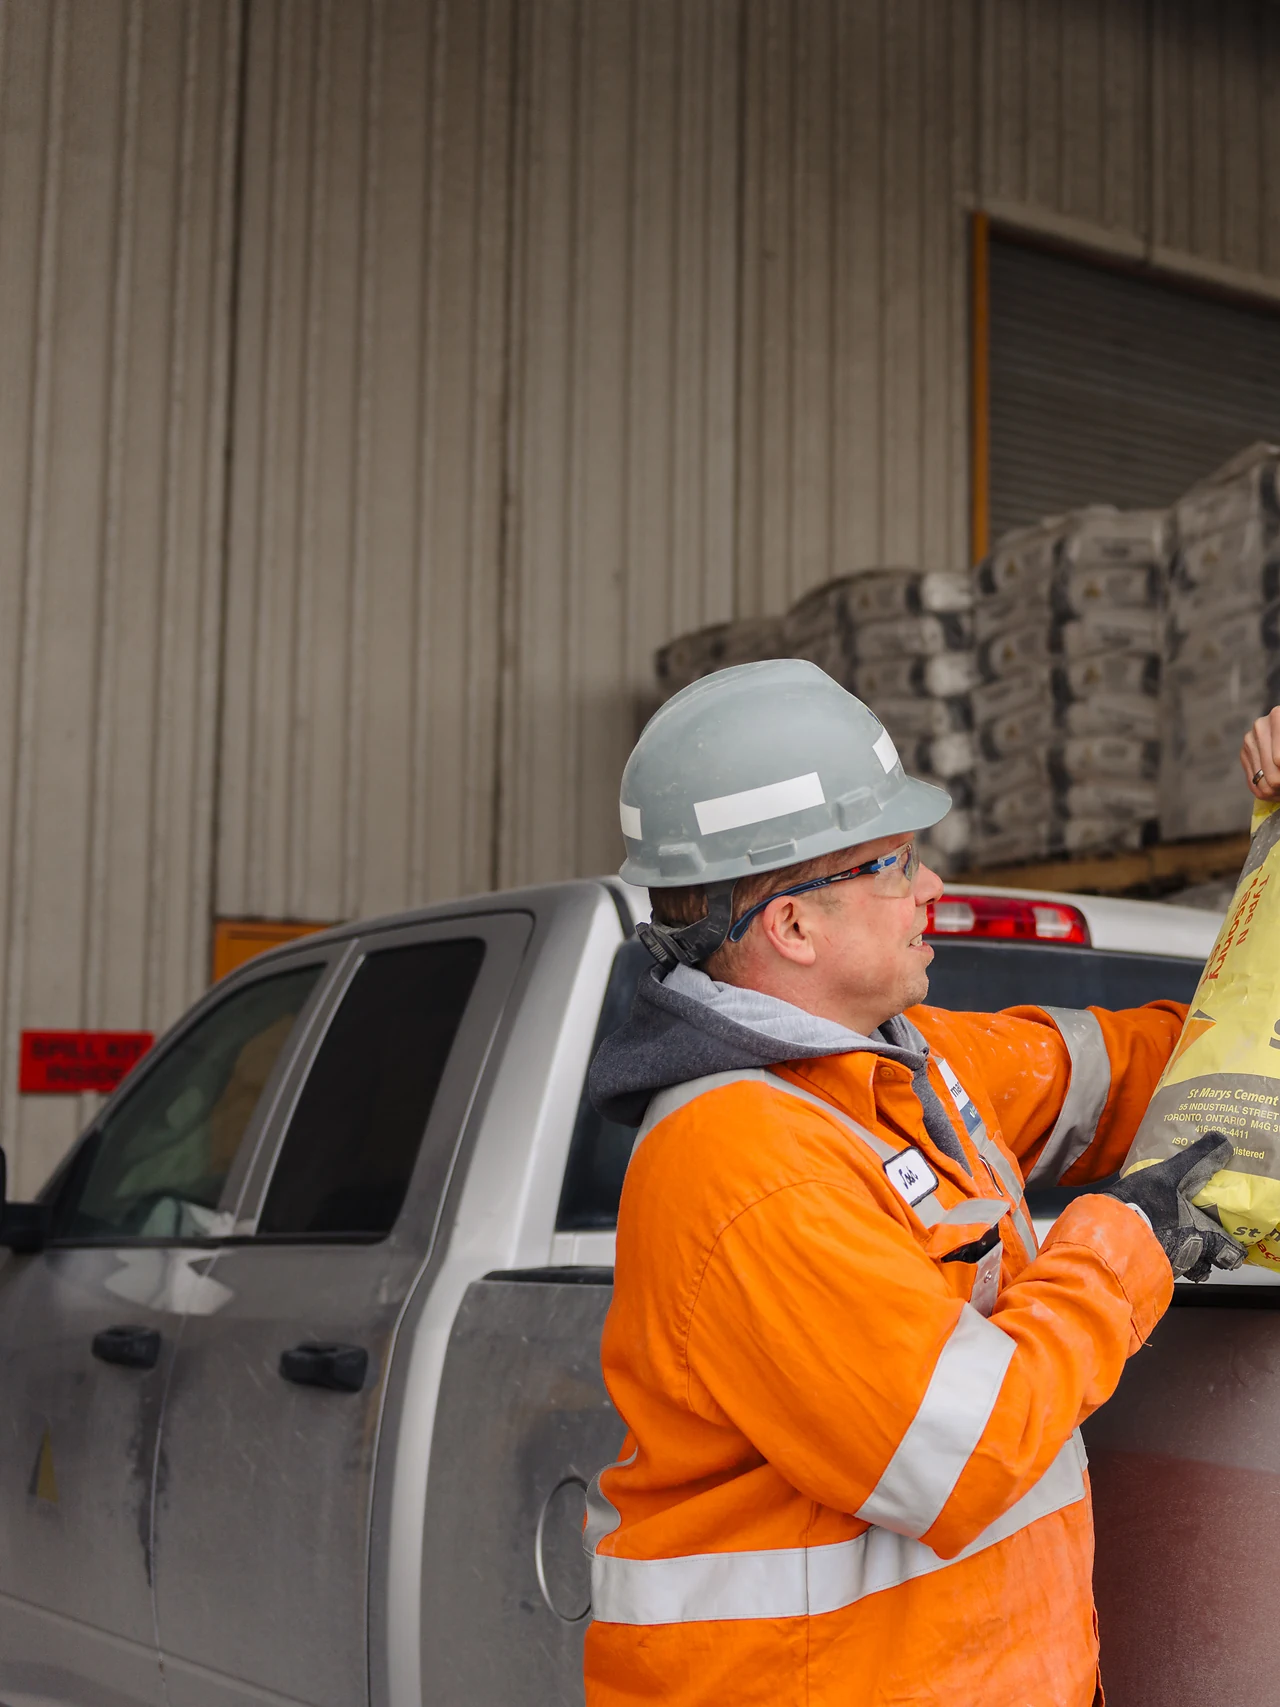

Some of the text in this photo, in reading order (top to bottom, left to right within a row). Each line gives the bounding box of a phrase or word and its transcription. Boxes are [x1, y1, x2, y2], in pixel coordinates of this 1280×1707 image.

[1235, 928, 1250, 947] N
[1187, 1087, 1279, 1107] St Marys Cement
[1178, 1102, 1280, 1121] 55 INDUSTRIAL STREET
[1205, 1113, 1247, 1127] ONTARIO
[1250, 1119, 1271, 1132] M4G
[1171, 1136, 1188, 1147] ISO
[1232, 1226, 1262, 1238] st
